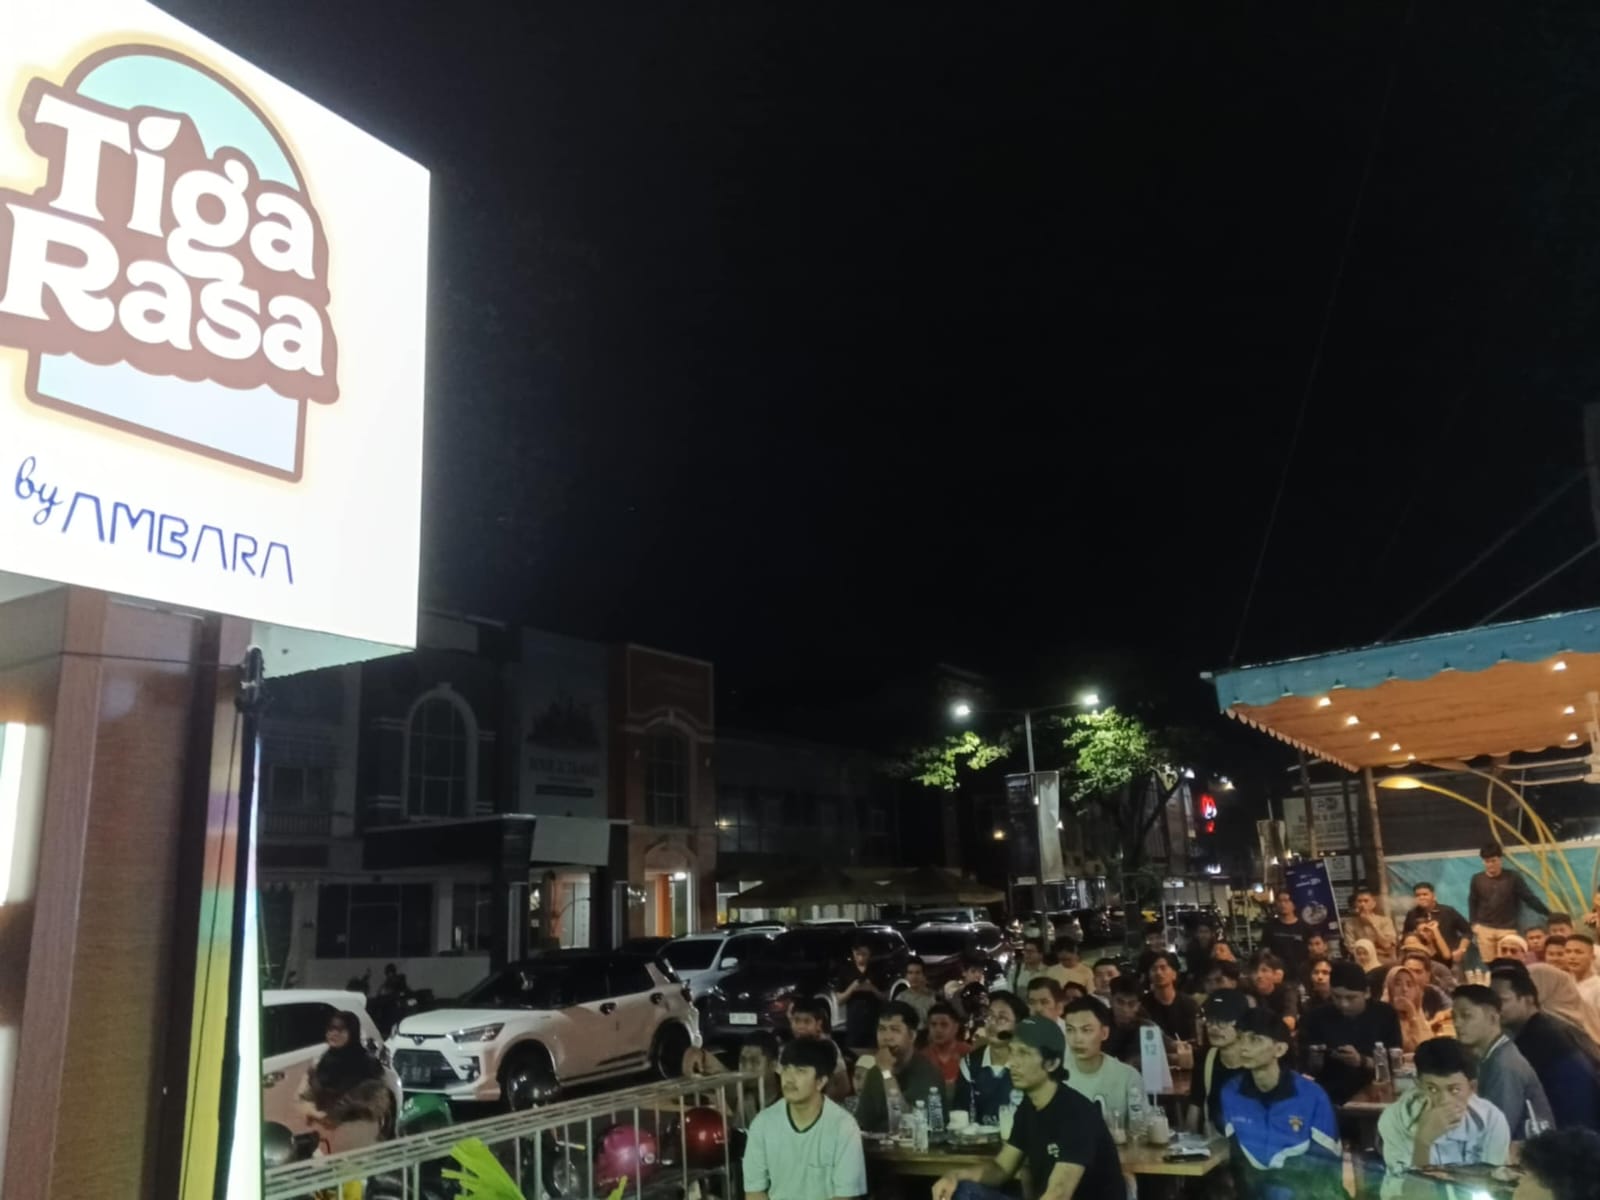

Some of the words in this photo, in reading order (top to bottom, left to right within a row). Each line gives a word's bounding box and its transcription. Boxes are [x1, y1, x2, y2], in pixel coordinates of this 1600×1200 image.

[34, 94, 316, 284] Tiga
[0, 203, 325, 376] Rasa
[15, 457, 63, 525] by
[63, 492, 294, 584] AMBARA
